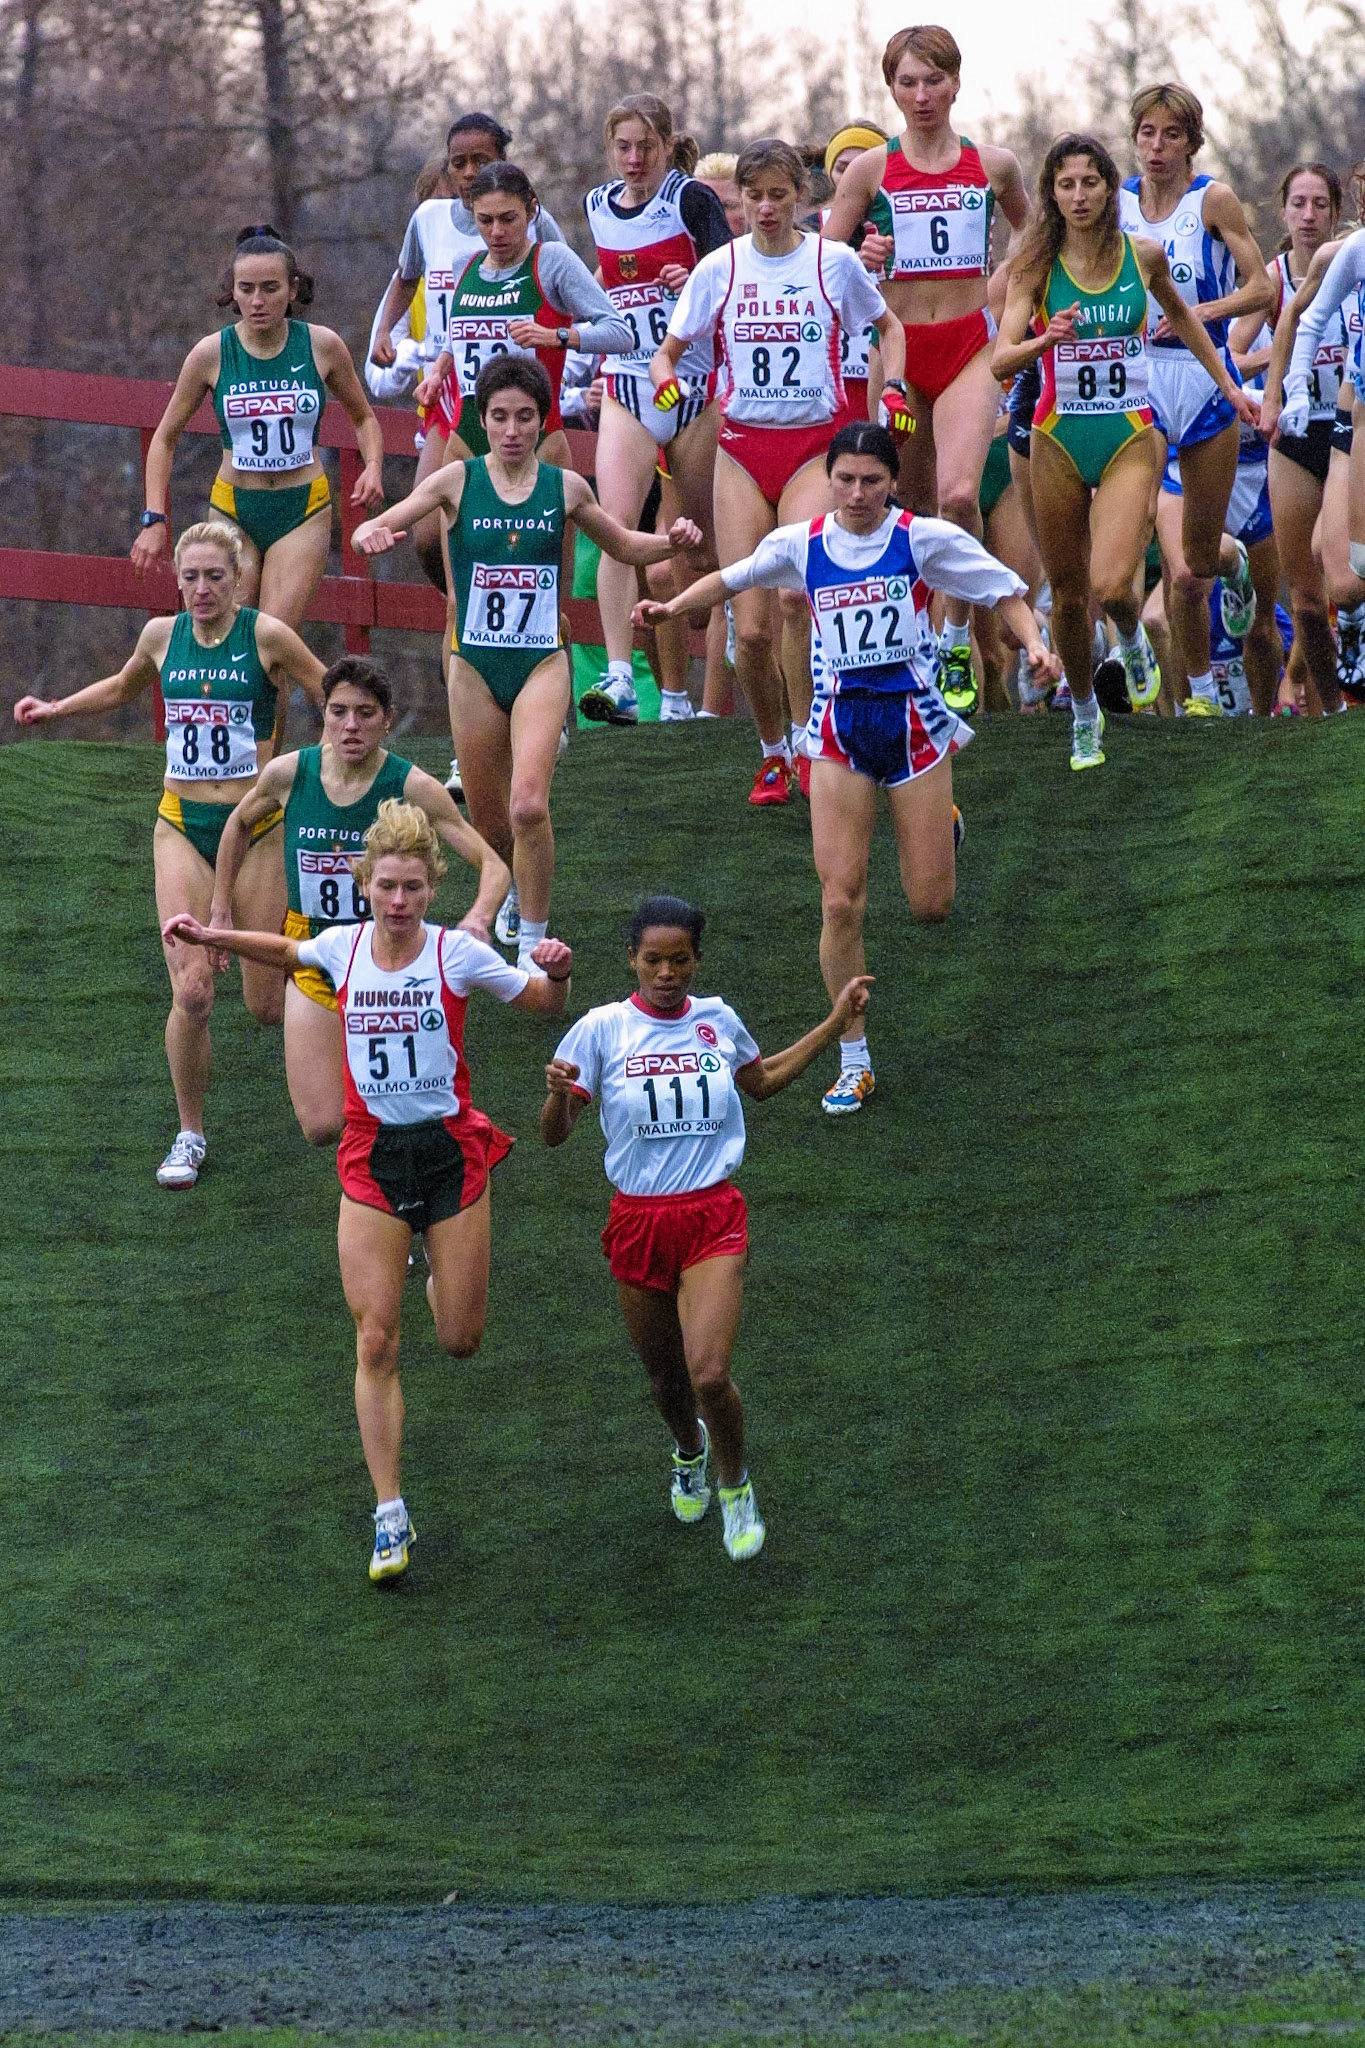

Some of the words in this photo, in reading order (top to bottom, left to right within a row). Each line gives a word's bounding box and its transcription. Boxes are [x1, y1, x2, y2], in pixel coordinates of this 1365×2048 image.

[895, 193, 961, 211] SPAR
[930, 216, 949, 255] 6
[901, 258, 953, 269] MALMO
[957, 255, 982, 265] 2000
[428, 273, 454, 288] SP
[459, 291, 520, 307] HUNGARY
[610, 287, 660, 309] SPAR
[737, 301, 815, 318] POLSKA
[1078, 304, 1131, 326] RTUGAL
[452, 322, 506, 338] SPAR
[735, 324, 800, 341] SPAR
[1058, 344, 1123, 361] SPAR
[1314, 349, 1344, 366] AR
[752, 346, 800, 386] 82
[230, 380, 306, 395] PORTUGAL
[1078, 362, 1126, 400] 89
[739, 388, 788, 398] MALMO
[793, 388, 822, 398] 2000
[228, 397, 295, 417] SPAR
[1062, 402, 1114, 412] MALMO
[1119, 397, 1146, 409] 2000
[250, 418, 295, 456] 90
[238, 456, 287, 468] MALMO
[290, 452, 311, 465] 2000
[473, 517, 555, 532] PORTUGAL
[475, 569, 536, 588] SPAR
[818, 583, 886, 611] SPAR
[486, 592, 536, 633] 87
[469, 631, 522, 645] MALMO
[525, 634, 554, 645] 2000
[833, 605, 903, 654] 122
[831, 652, 882, 669] MALMO
[886, 646, 916, 661] 2000
[168, 668, 249, 684] PORTUGAL
[1218, 681, 1236, 710] 5
[167, 704, 229, 723] SPAR
[182, 724, 231, 765] 88
[170, 763, 219, 777] MALMO
[222, 763, 254, 776] 2000
[299, 827, 370, 842] PORTUG
[302, 854, 366, 872] SPA
[320, 879, 372, 918] 86
[354, 990, 435, 1007] HUNGARY
[348, 1013, 418, 1032] SPAR
[368, 1034, 417, 1080] 51
[626, 1055, 698, 1076] SPAR
[414, 1077, 447, 1091] 2000
[643, 1074, 710, 1122] 111
[638, 1122, 692, 1135] MALMO
